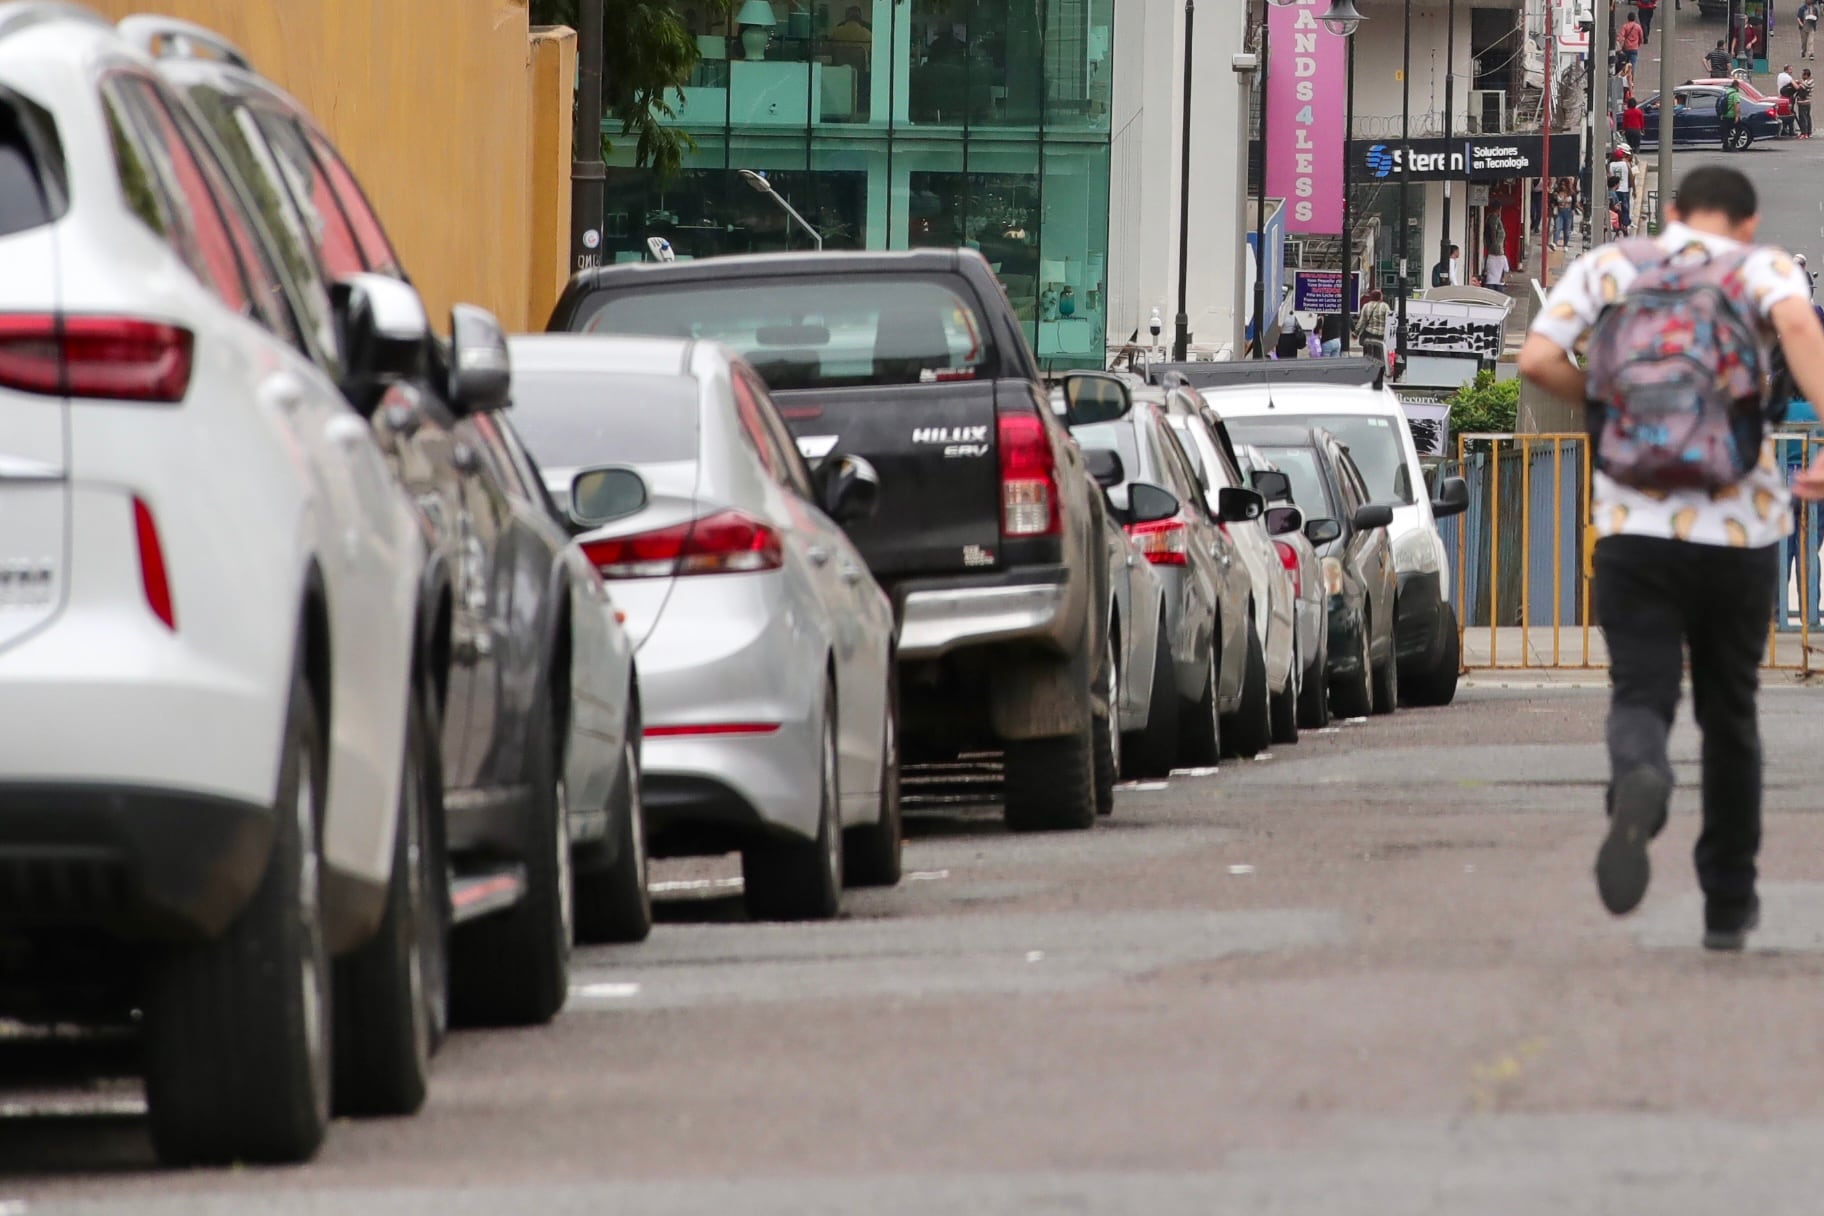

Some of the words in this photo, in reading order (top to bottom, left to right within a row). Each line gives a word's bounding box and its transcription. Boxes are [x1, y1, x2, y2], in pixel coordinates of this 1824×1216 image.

[1473, 146, 1518, 157] Soluciones
[1392, 149, 1463, 173] Steren
[1473, 161, 1485, 169] en
[912, 426, 987, 443] HILUX
